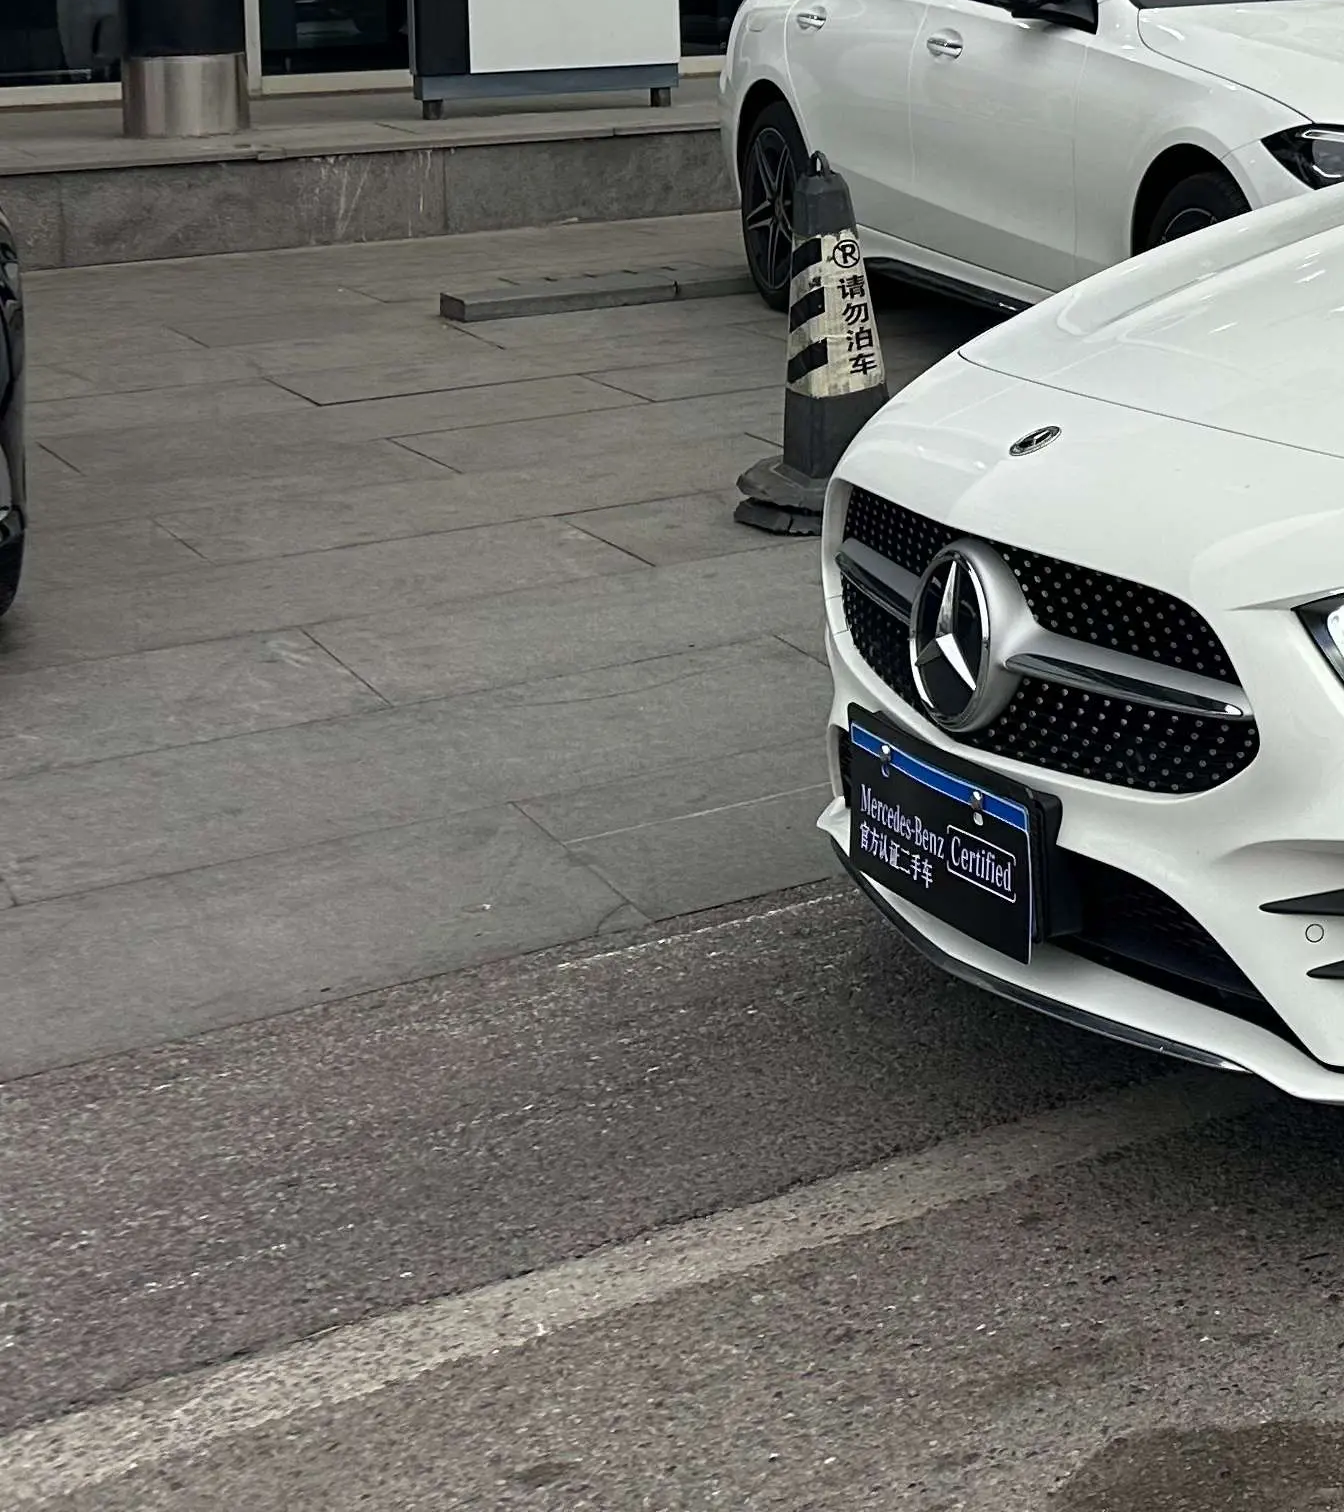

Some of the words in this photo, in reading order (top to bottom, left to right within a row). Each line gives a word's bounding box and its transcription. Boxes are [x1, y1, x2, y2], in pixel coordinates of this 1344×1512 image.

[837, 273, 878, 377] 请勿泊车
[859, 783, 946, 861] Mercedes-Benz
[950, 835, 1014, 893] Certified
[859, 820, 934, 890] 官方认证二手车
